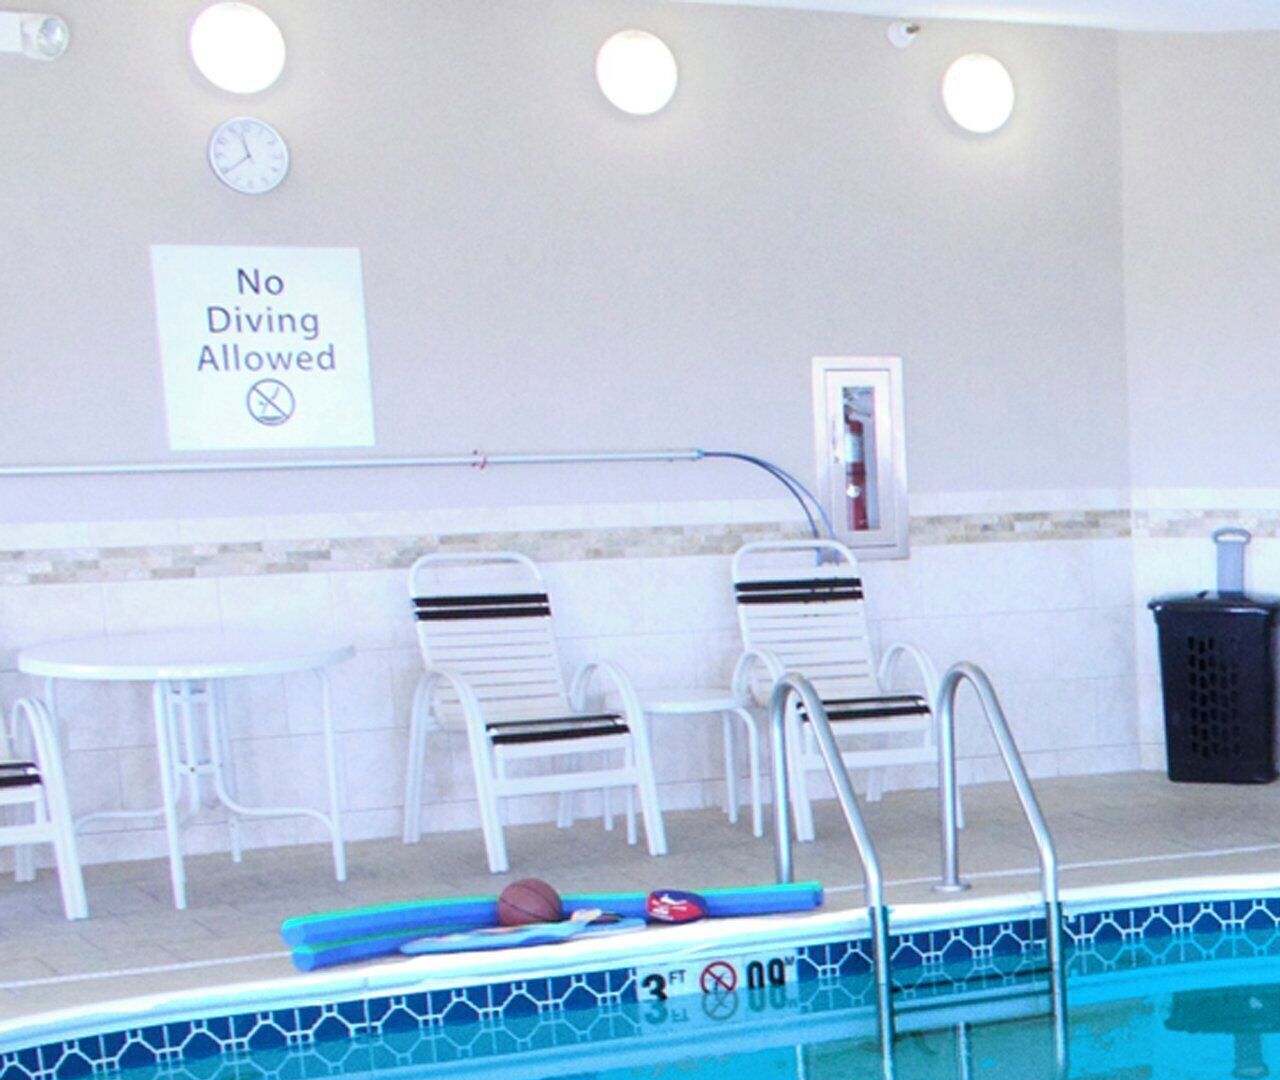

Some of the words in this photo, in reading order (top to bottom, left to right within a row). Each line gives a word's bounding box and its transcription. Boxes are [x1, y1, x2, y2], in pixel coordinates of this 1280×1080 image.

[237, 268, 284, 295] No
[207, 306, 319, 341] Diving
[198, 343, 336, 372] Allowed
